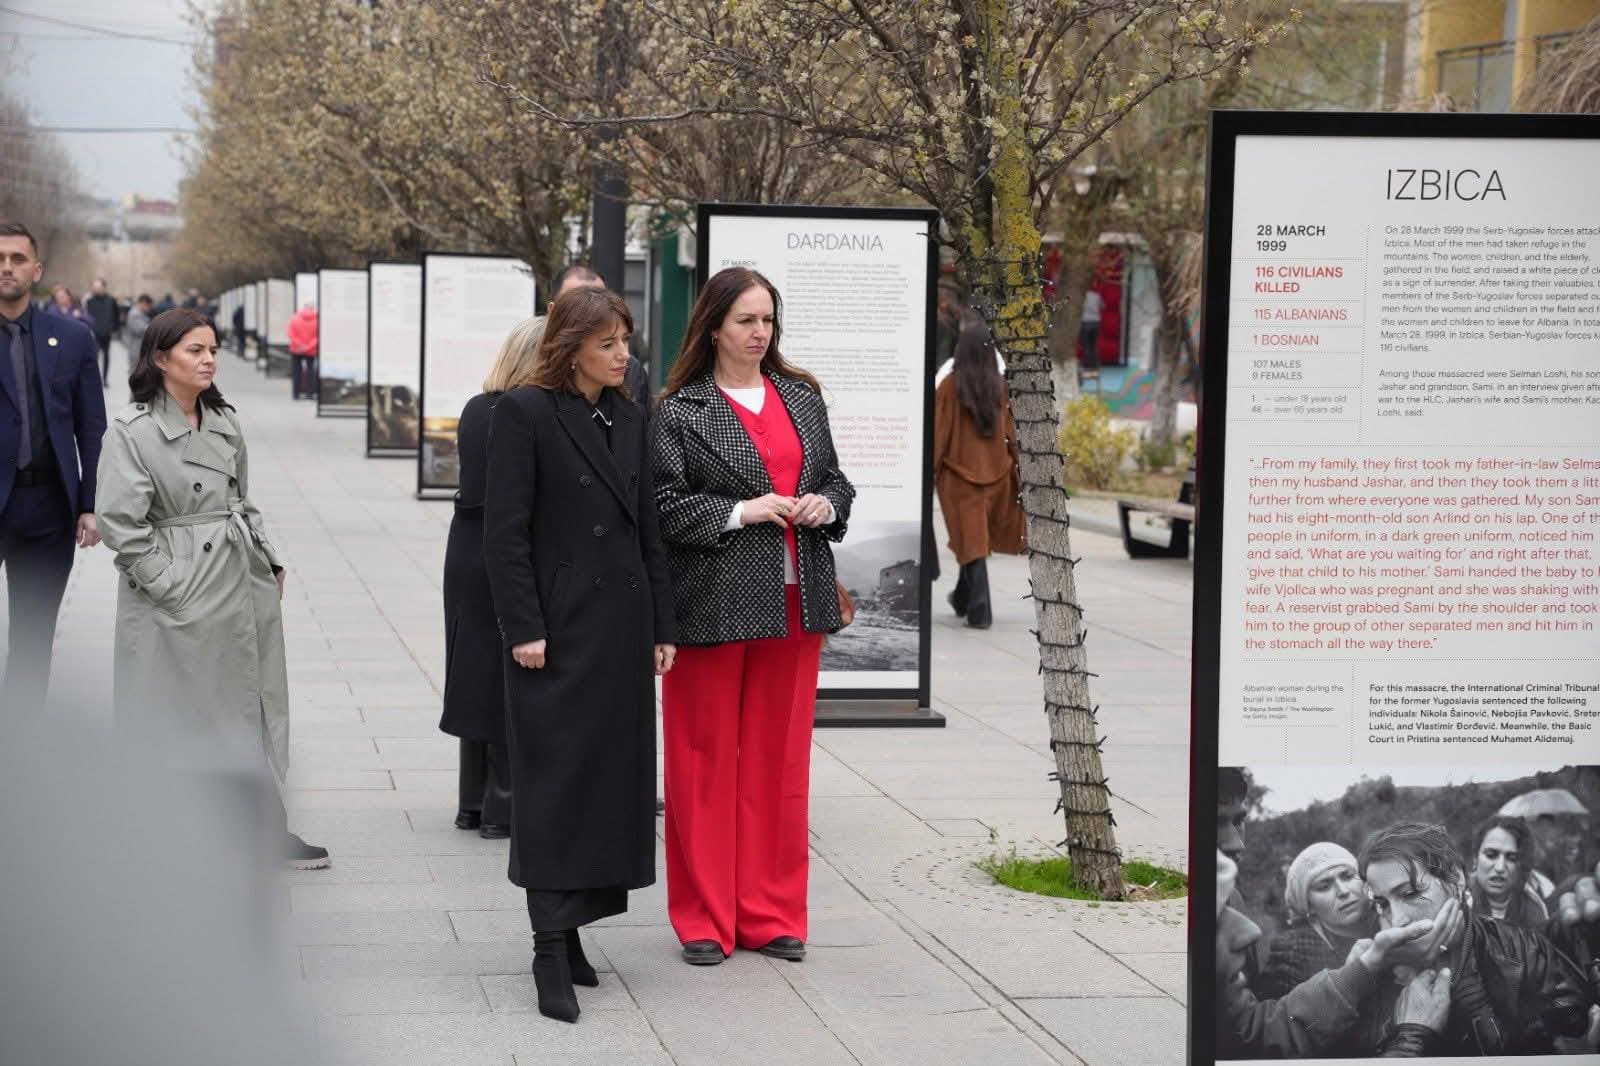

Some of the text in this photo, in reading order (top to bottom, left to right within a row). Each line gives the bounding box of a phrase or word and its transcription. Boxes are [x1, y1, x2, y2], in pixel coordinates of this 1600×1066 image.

[1387, 169, 1506, 201] IZBICA
[1256, 225, 1326, 236] 28 MARCH
[787, 233, 884, 251] DARDANIA
[1256, 240, 1287, 252] 1999
[1255, 266, 1344, 278] 116 CIVILIANS
[1255, 282, 1301, 293] KILLED
[1254, 309, 1347, 321] 115 ALBANIANS
[1253, 334, 1319, 346] 1 BOSNIAN
[1253, 360, 1302, 369] 107 MALES
[1252, 372, 1302, 380] 9 FEMALES
[1298, 461, 1317, 472] my
[1362, 458, 1391, 472] they
[1394, 458, 1418, 469] first
[1422, 458, 1450, 469] took
[1454, 461, 1473, 472] my
[1476, 458, 1559, 469] father-in-law
[1249, 477, 1278, 488] then
[1281, 479, 1301, 490] my
[1304, 477, 1359, 488] husband
[1410, 477, 1434, 488] and
[1438, 477, 1467, 488] then
[1471, 477, 1499, 490] they
[1502, 477, 1531, 488] took
[1535, 477, 1568, 488] them
[1571, 479, 1579, 488] a
[1249, 495, 1291, 505] further
[1296, 495, 1324, 505] from
[1328, 495, 1366, 505] where
[1370, 497, 1429, 508] everyone
[1433, 497, 1457, 505] was
[1524, 495, 1544, 508] My
[1548, 497, 1572, 505] son
[1248, 513, 1272, 524] had
[1275, 513, 1294, 524] his
[1297, 513, 1402, 526] eight-month-old
[1406, 515, 1429, 524] son
[1433, 513, 1472, 524] Arlind
[1474, 515, 1490, 524] on
[1494, 513, 1513, 524] his
[1541, 513, 1569, 524] One
[1572, 513, 1585, 524] of
[1247, 531, 1292, 545] people
[1295, 531, 1307, 542] in
[1366, 531, 1377, 542] in
[1379, 533, 1388, 542] a
[1390, 531, 1419, 542] dark
[1422, 533, 1461, 545] green
[1518, 531, 1568, 542] noticed
[1571, 531, 1594, 542] him
[1247, 549, 1271, 560] and
[1346, 551, 1367, 560] are
[1370, 551, 1393, 563] you
[1397, 549, 1442, 563] waiting
[1469, 549, 1494, 560] and
[1497, 549, 1526, 563] right
[1530, 549, 1560, 560] after
[1369, 684, 1384, 692] For
[1387, 684, 1403, 692] this
[1450, 684, 1465, 692] the
[1467, 684, 1524, 692] International
[1525, 684, 1563, 692] Criminal
[1565, 684, 1600, 692] Tribunal
[1369, 697, 1587, 707] for the former Yugoslavia sentenced the following
[1420, 709, 1448, 717] Nikola
[1397, 722, 1414, 730] and
[1416, 722, 1453, 730] Vlastimir
[1551, 722, 1566, 730] the
[1568, 722, 1591, 730] Basic
[1368, 735, 1394, 743] Court
[1396, 735, 1405, 743] in
[1407, 735, 1440, 743] Pristina
[1443, 735, 1489, 743] sentenced
[1490, 735, 1532, 743] Muhamet
